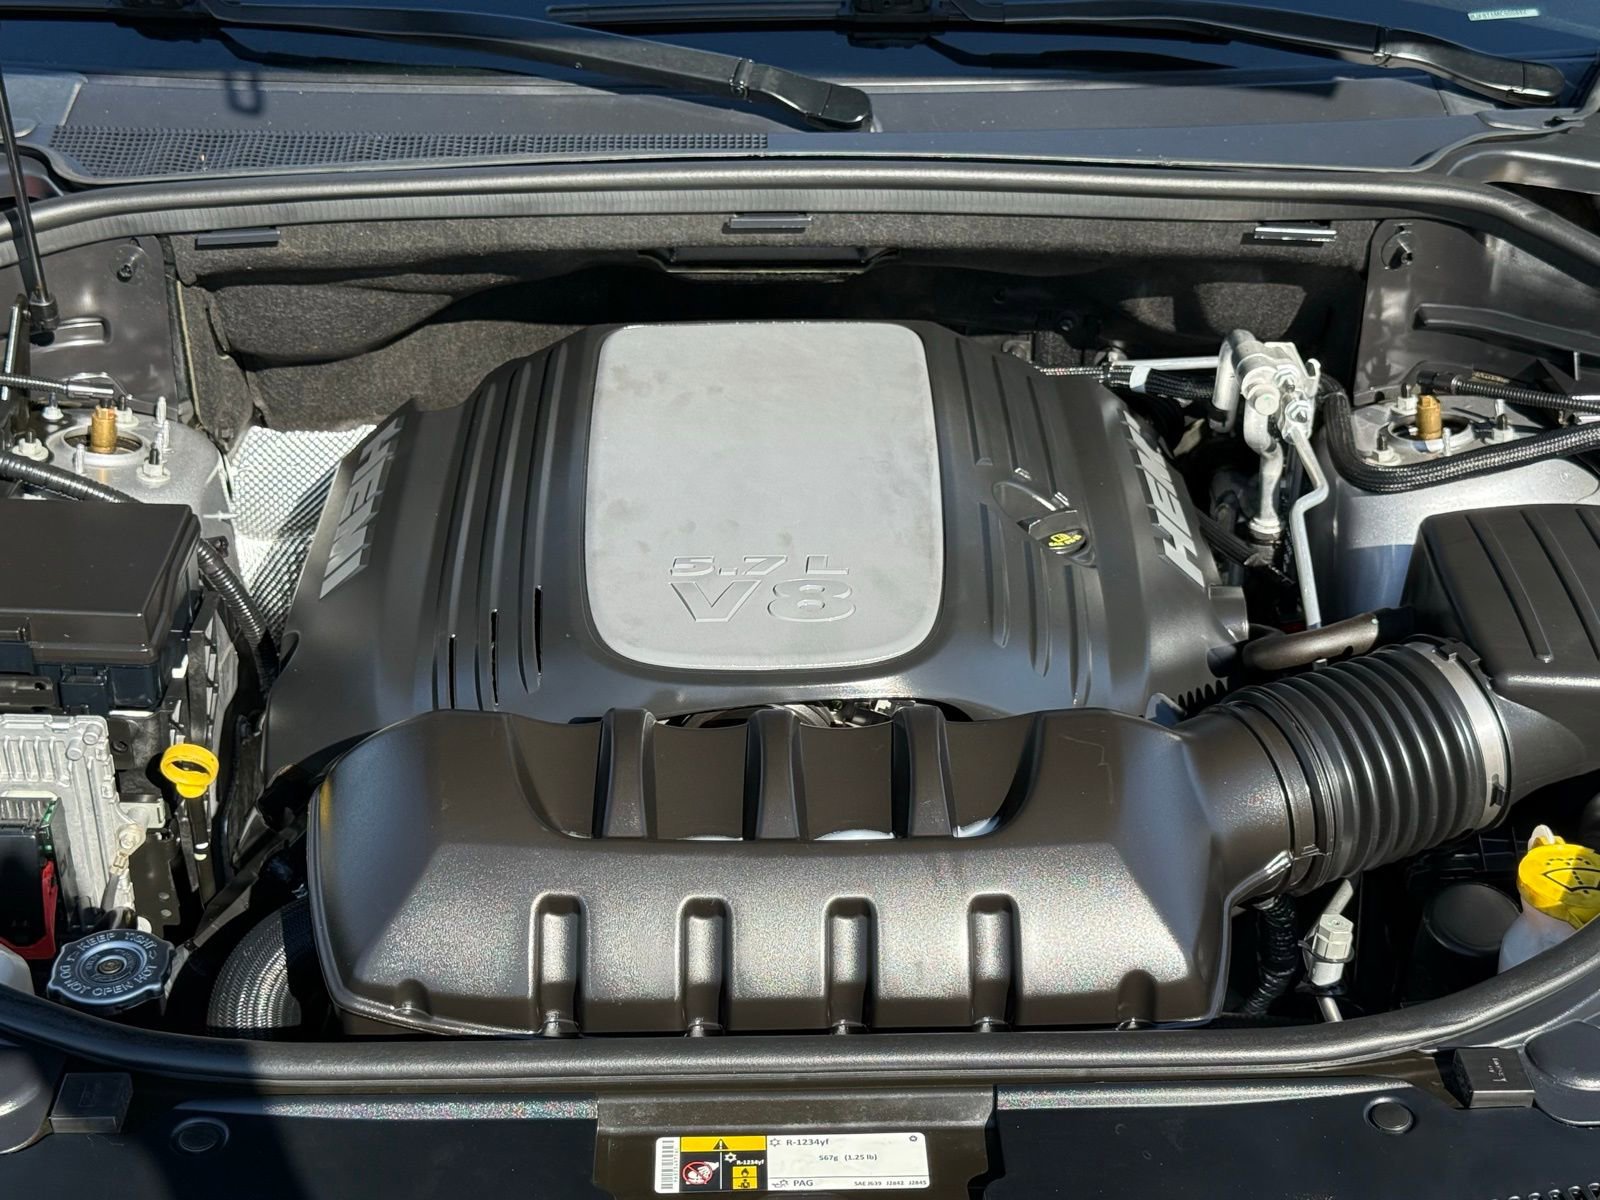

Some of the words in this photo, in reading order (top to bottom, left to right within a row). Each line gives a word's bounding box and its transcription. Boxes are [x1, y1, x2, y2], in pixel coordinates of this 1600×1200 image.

[319, 416, 402, 600] HEMI
[1121, 410, 1205, 588] HEMI
[668, 579, 857, 623] V8
[77, 932, 117, 951] KEEP
[92, 981, 134, 997] OPEN
[134, 965, 158, 983] HOT
[786, 1138, 829, 1147] R-1234yf
[819, 1154, 839, 1162] 567g
[844, 1154, 865, 1162] (1.25
[793, 1179, 814, 1187] PAG
